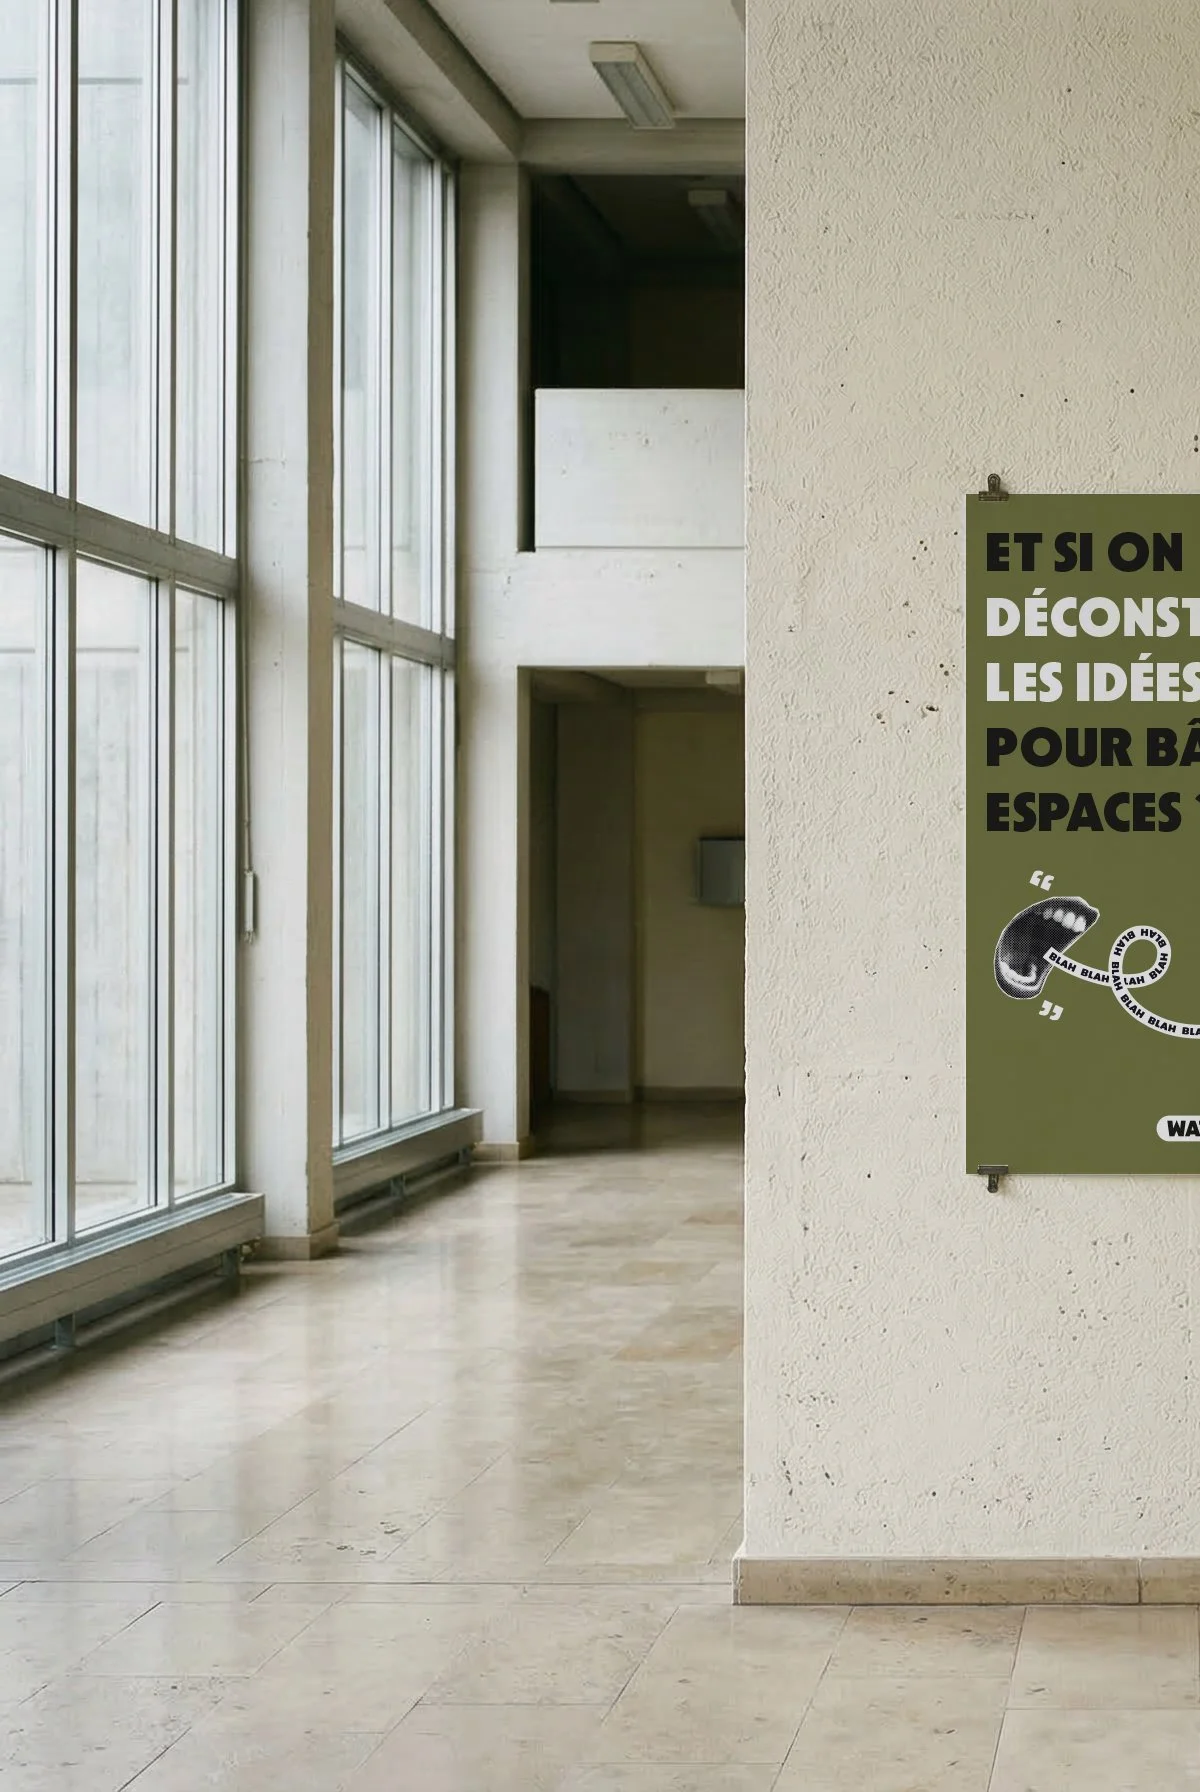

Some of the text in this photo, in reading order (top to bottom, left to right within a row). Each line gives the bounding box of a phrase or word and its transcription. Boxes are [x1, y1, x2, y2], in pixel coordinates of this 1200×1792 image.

[986, 531, 1183, 573] ET SI ON
[986, 661, 1063, 703] LES
[986, 726, 1133, 768] POUR
[986, 791, 1182, 833] ESPACES
[1113, 930, 1136, 957] BLAH
[1140, 928, 1167, 948] BLAH
[1048, 951, 1077, 973] BLAH
[1080, 968, 1110, 983] BLAH
[1148, 952, 1169, 980] BLAH
[1111, 961, 1123, 991] BLAH
[1123, 975, 1145, 985] LAH
[1120, 994, 1146, 1019] BLAH
[1147, 1016, 1177, 1033] BLAH
